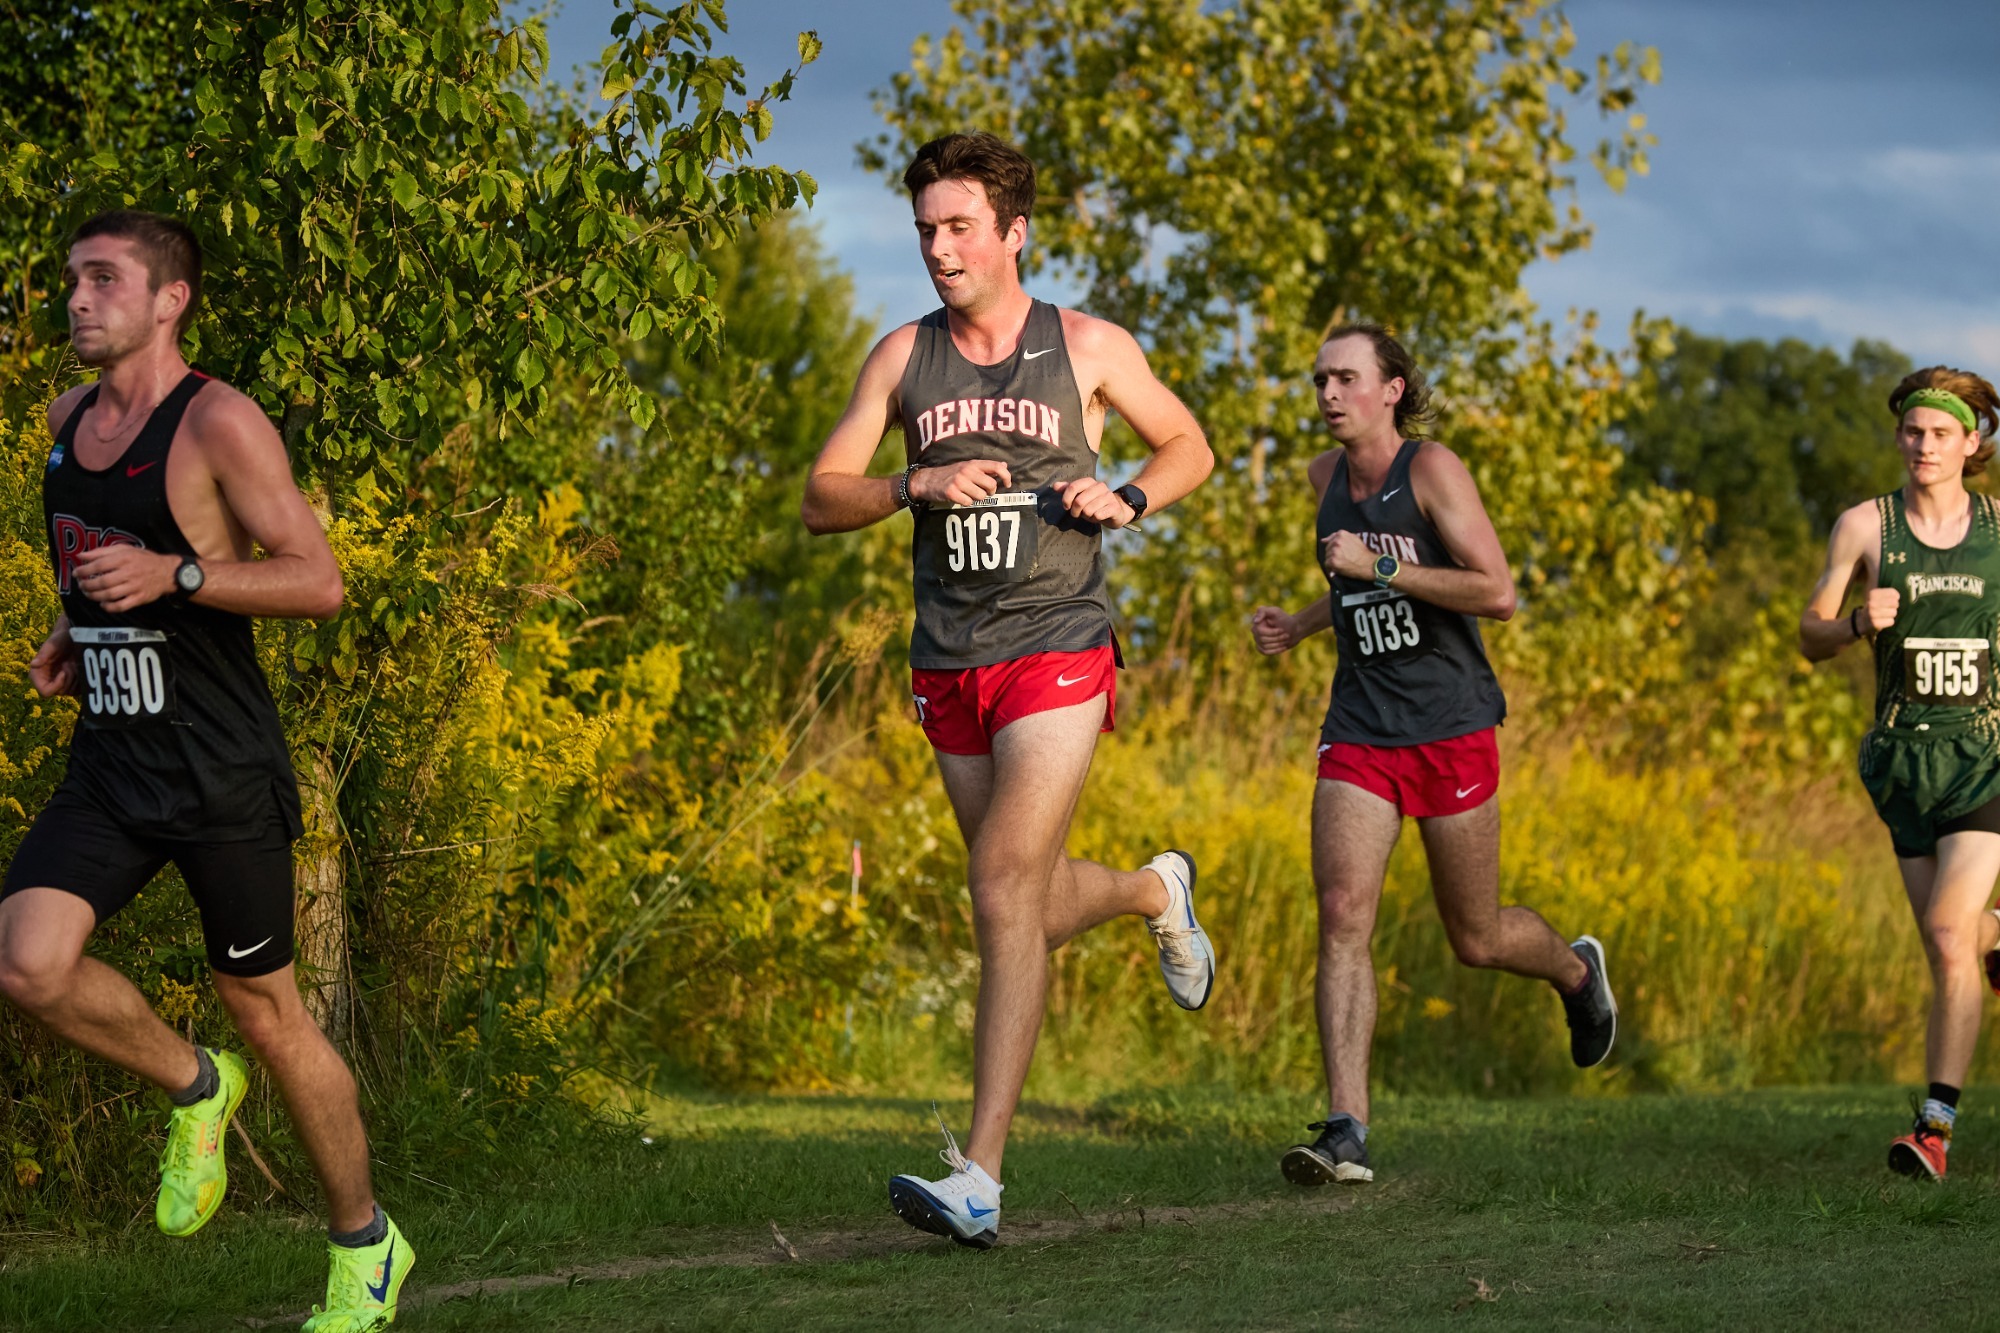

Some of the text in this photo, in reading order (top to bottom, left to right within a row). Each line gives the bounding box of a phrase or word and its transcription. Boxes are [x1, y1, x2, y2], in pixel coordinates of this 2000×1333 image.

[917, 398, 1061, 452] DENISON
[945, 511, 1021, 572] 9137
[1355, 530, 1420, 566] ISON
[1906, 573, 1985, 604] FRANCISCAN
[1353, 600, 1421, 656] 9133
[84, 647, 165, 715] 9390
[1915, 650, 1979, 697] 9155
